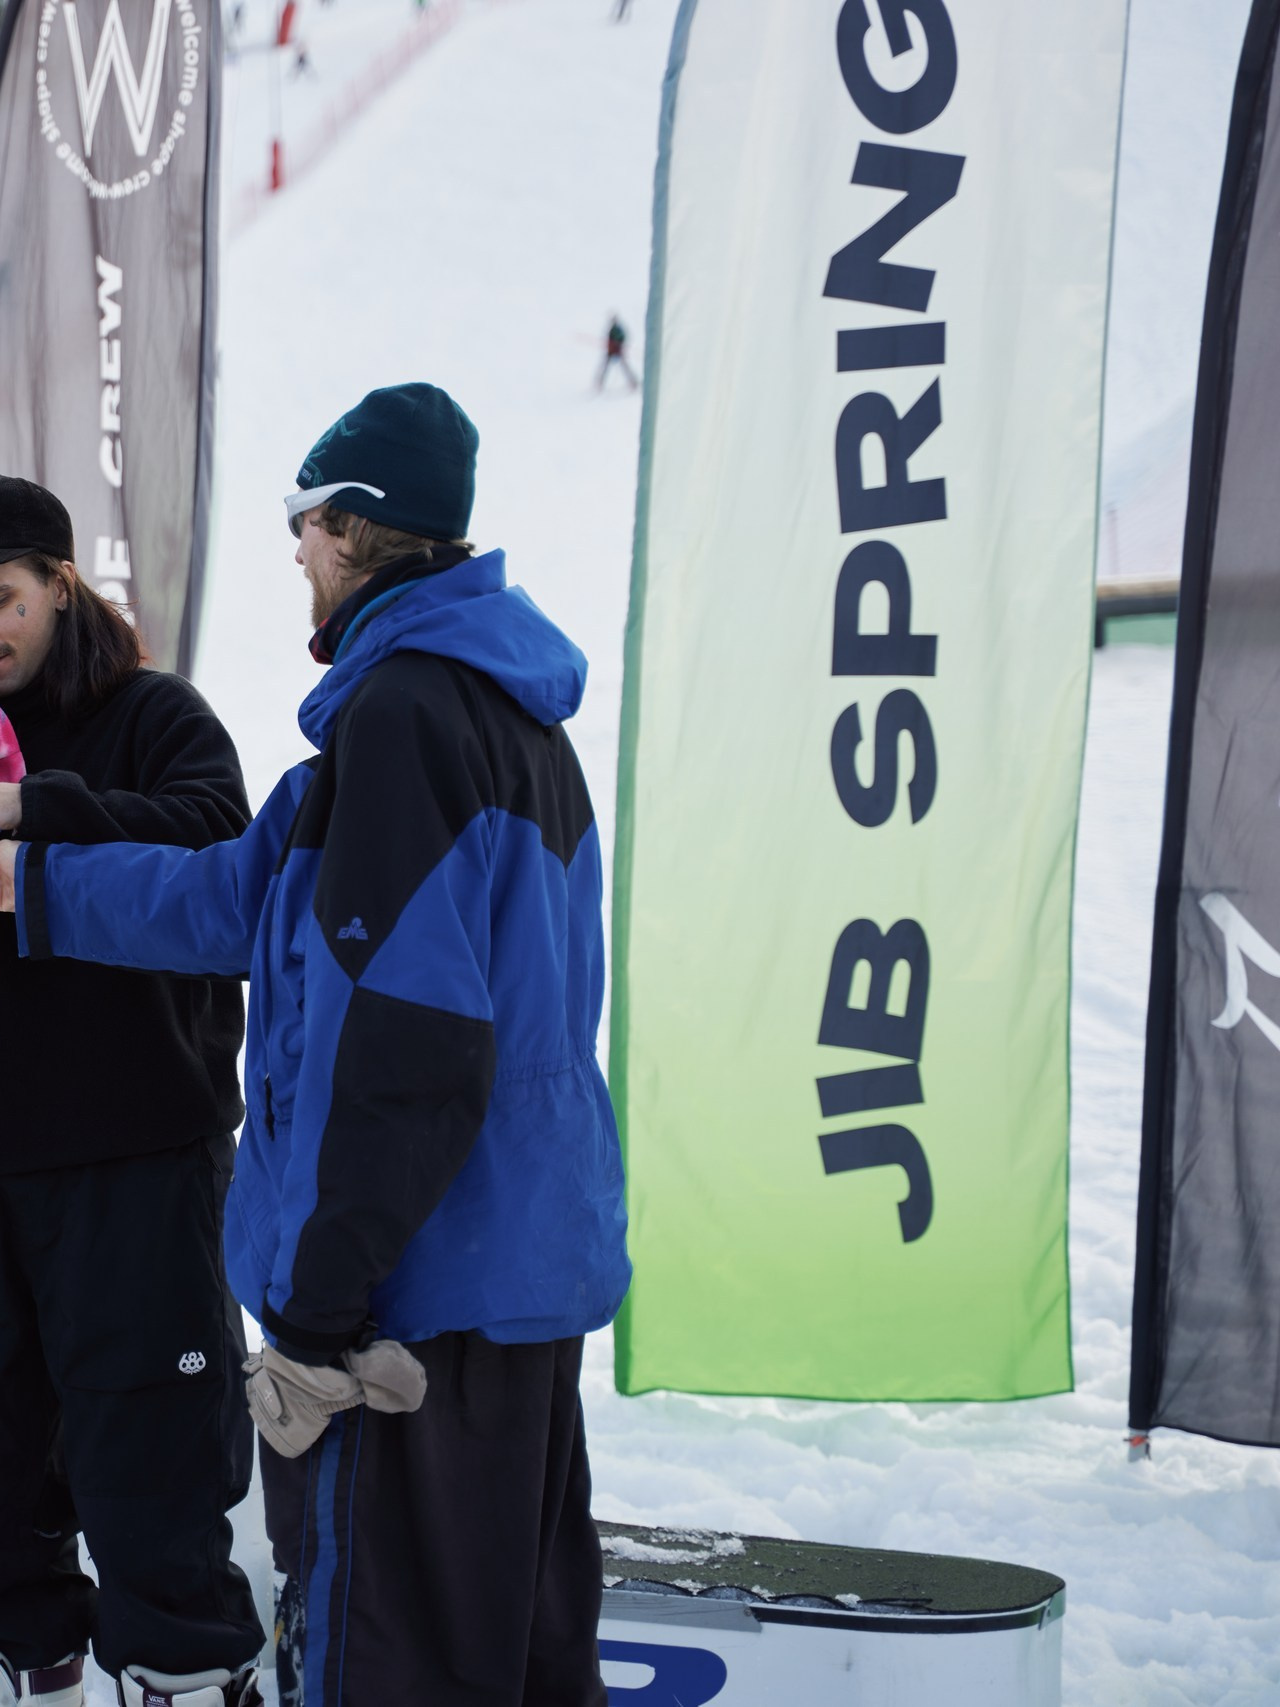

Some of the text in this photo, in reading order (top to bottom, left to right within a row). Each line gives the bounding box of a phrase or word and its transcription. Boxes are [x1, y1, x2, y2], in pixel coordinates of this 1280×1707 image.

[96, 255, 124, 489] CREW
[815, 0, 967, 1244] JIB SPRING
[178, 1351, 207, 1374] 686
